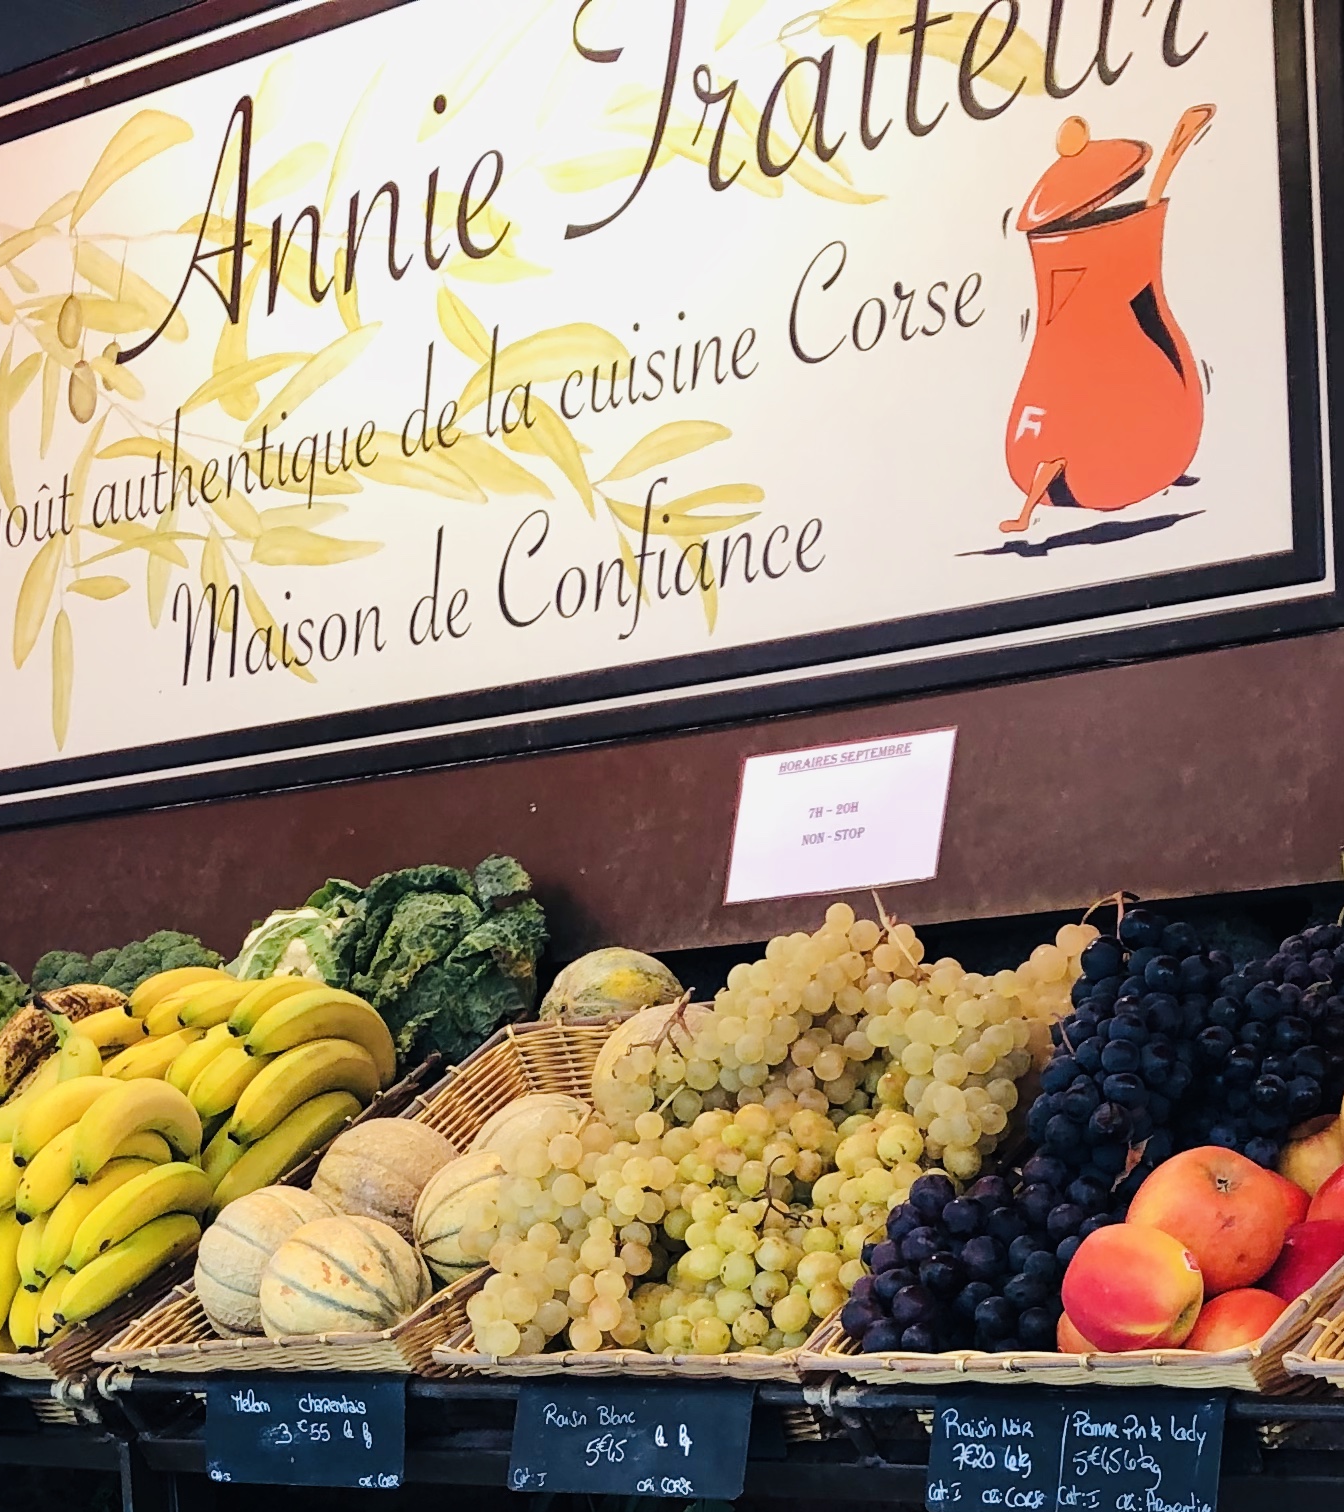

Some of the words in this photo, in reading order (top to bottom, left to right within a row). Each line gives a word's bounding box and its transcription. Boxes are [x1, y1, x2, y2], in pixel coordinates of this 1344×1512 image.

[116, 94, 510, 365] Annie
[566, 0, 1210, 240] Traiteur
[93, 407, 378, 508] authentique
[402, 341, 461, 457] de
[486, 325, 536, 437] la
[560, 311, 759, 419] cuisine
[788, 241, 985, 364] Corse
[172, 583, 387, 685] Maison
[409, 526, 471, 645] de
[498, 477, 826, 639] Confiance
[779, 755, 838, 774] HORAIRES
[840, 742, 912, 764] SEPTEMBRE
[809, 807, 823, 819] 7H
[836, 802, 859, 815] 20H
[801, 831, 825, 846] NON
[834, 827, 865, 841] STOP
[231, 1389, 271, 1412] Melon
[543, 1403, 587, 1427] Raisin
[597, 1405, 636, 1426] Blanc
[941, 1407, 997, 1440] Raisin
[1072, 1410, 1120, 1439] Pomme
[1122, 1413, 1163, 1442] Pink
[1171, 1414, 1207, 1456] Lady
[953, 1443, 996, 1473] 7€20
